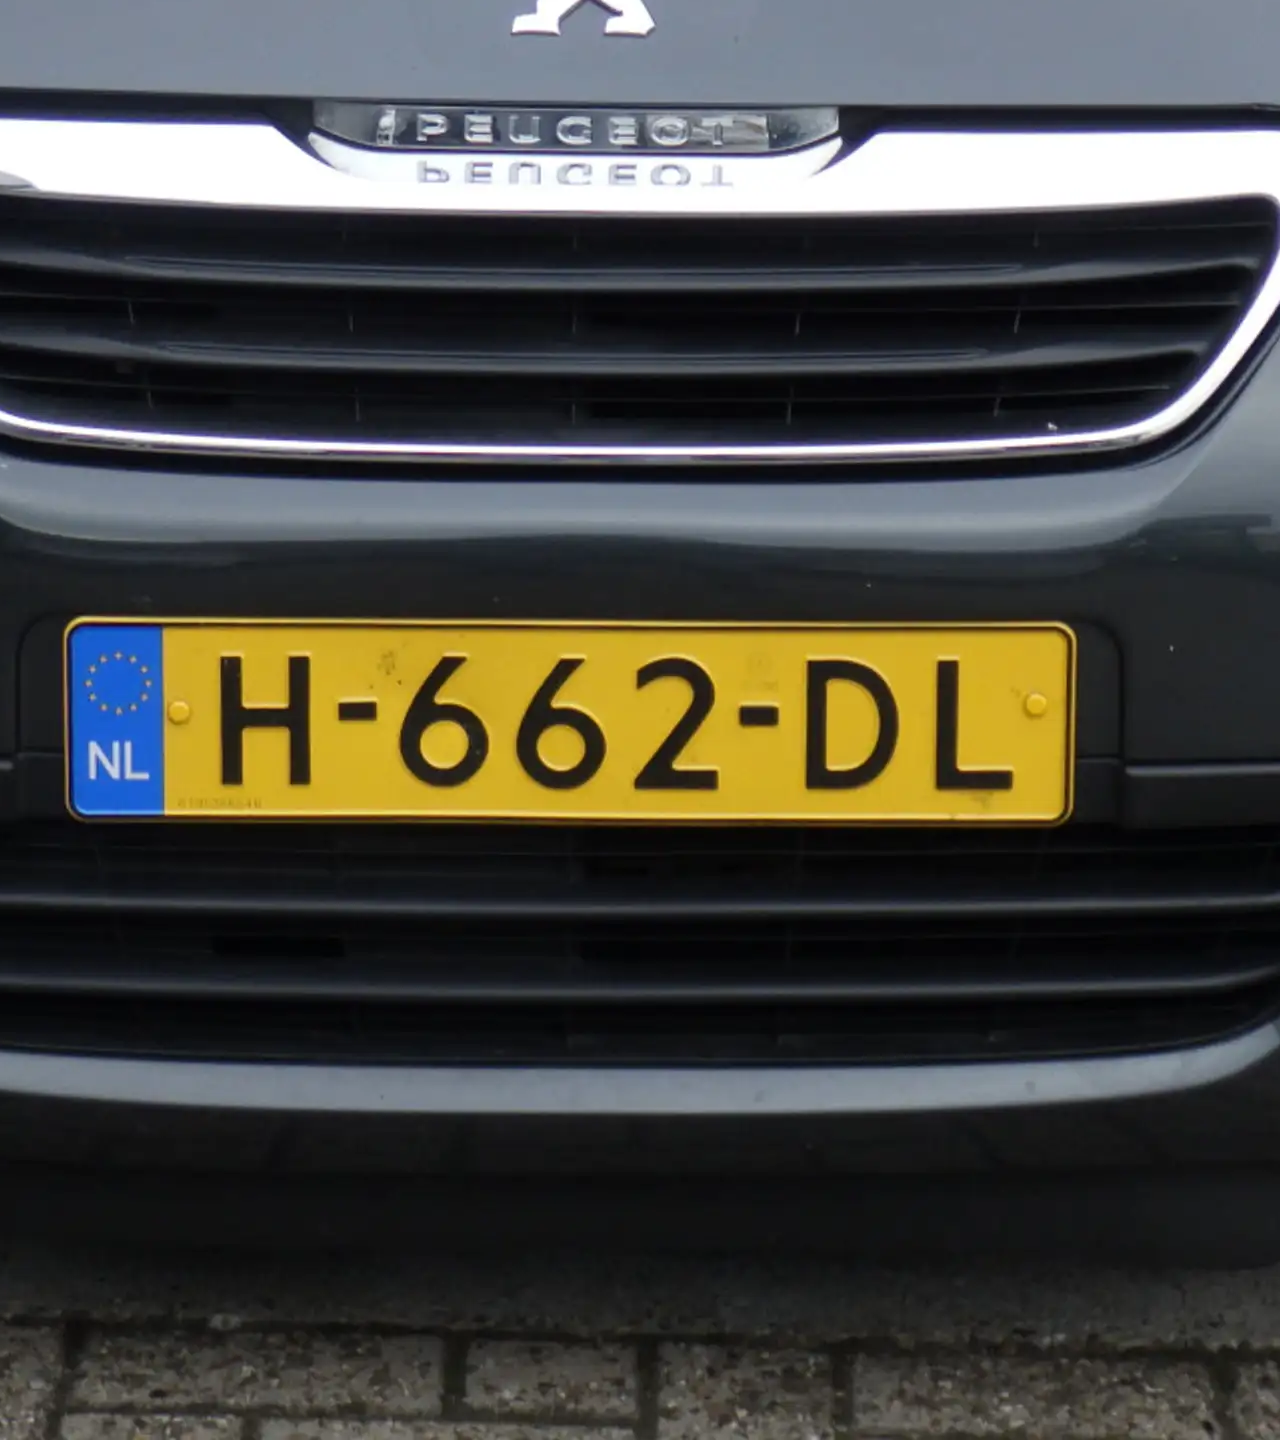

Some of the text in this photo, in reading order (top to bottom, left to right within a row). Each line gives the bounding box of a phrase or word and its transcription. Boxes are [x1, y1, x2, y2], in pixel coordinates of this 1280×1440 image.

[416, 113, 734, 147] PEUGEOT
[219, 654, 1013, 793] H-662-DL
[87, 741, 149, 781] NL
